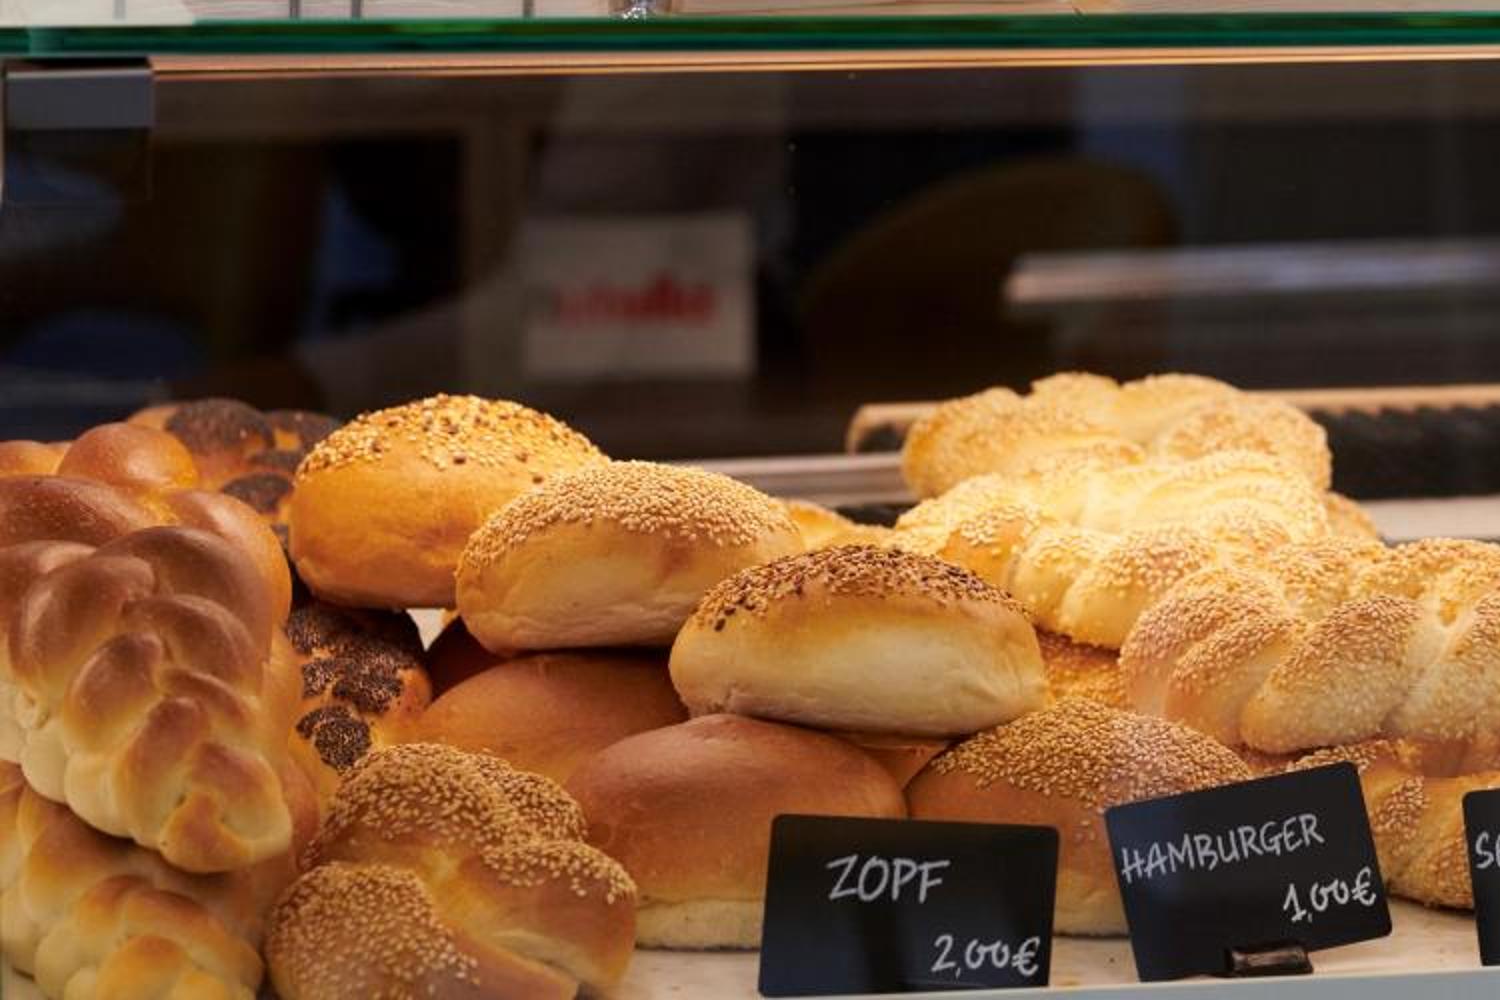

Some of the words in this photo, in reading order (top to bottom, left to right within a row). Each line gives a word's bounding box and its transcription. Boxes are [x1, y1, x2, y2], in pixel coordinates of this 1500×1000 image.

[1120, 812, 1325, 884] HAMBURGER
[827, 853, 950, 904] ZOPF
[1282, 866, 1377, 923] 1,00€
[931, 934, 1041, 978] 2,00€
